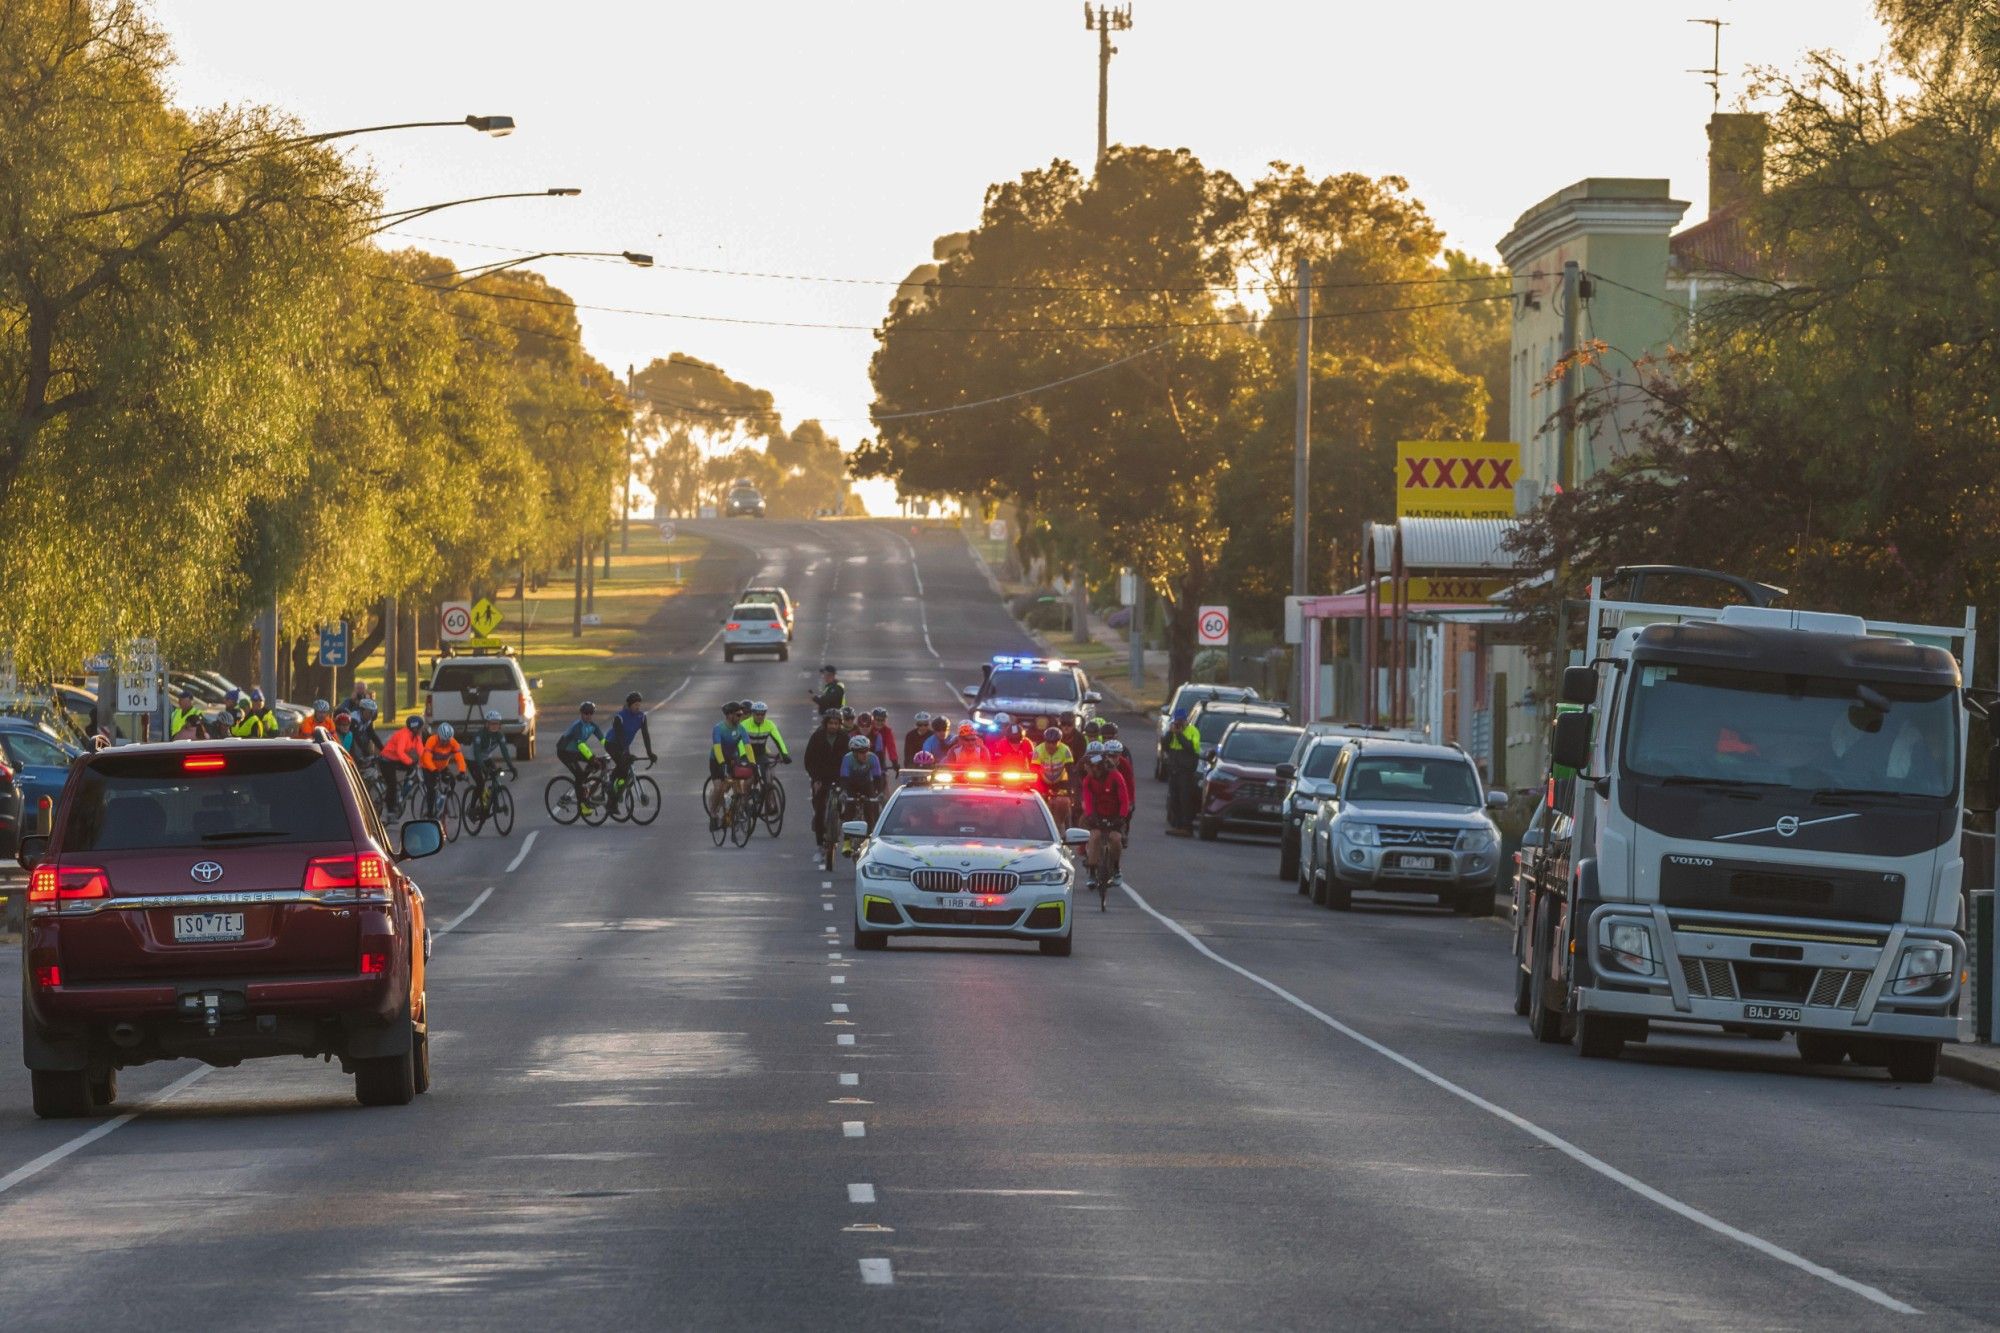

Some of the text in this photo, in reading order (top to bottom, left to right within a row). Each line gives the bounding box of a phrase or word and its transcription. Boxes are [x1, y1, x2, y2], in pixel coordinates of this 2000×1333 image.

[1404, 457, 1513, 489] XXXX
[1405, 509, 1511, 519] NATIONAL HOTEL
[1428, 581, 1482, 597] XXXX
[448, 615, 465, 627] 60
[1206, 619, 1222, 631] 60
[128, 694, 148, 706] 10 t
[1670, 856, 1713, 866] VOLVO
